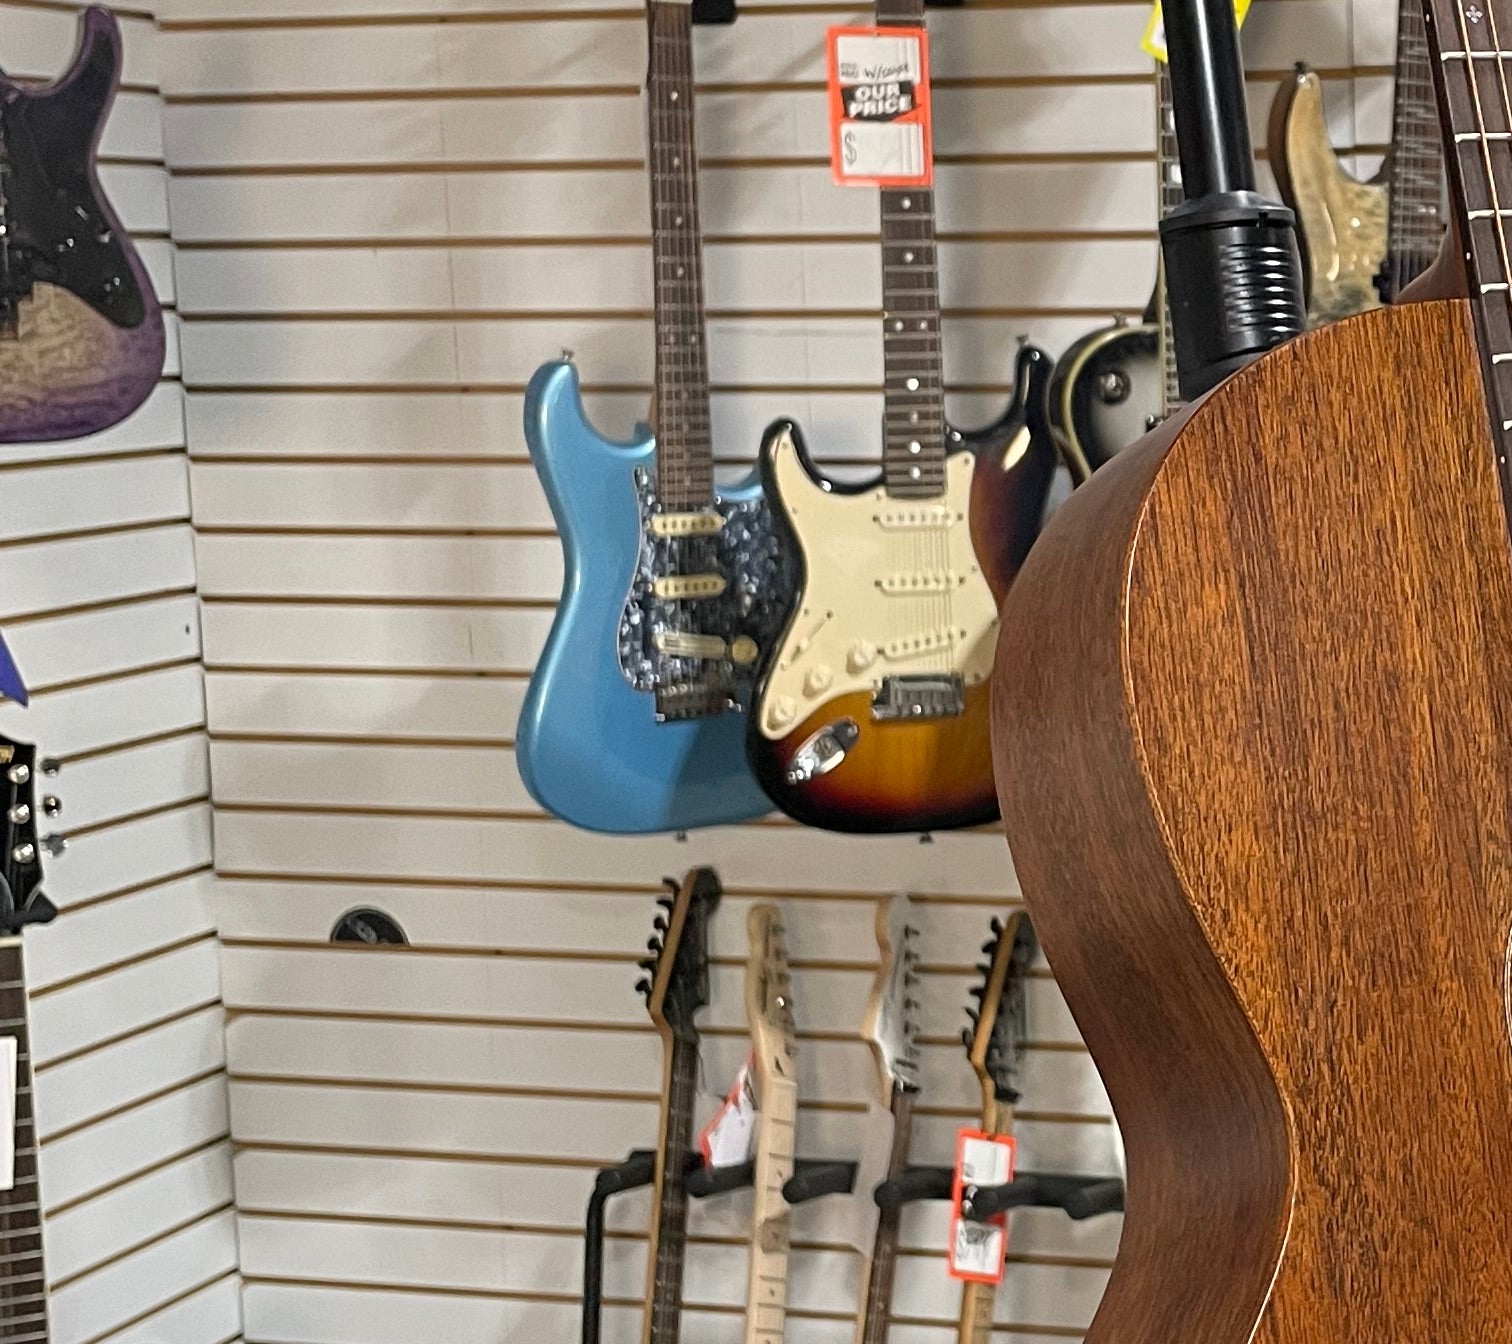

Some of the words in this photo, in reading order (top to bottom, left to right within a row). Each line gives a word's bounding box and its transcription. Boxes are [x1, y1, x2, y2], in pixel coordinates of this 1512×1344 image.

[855, 85, 901, 100] OUR
[848, 96, 913, 116] PRICE
[844, 131, 857, 165] $
